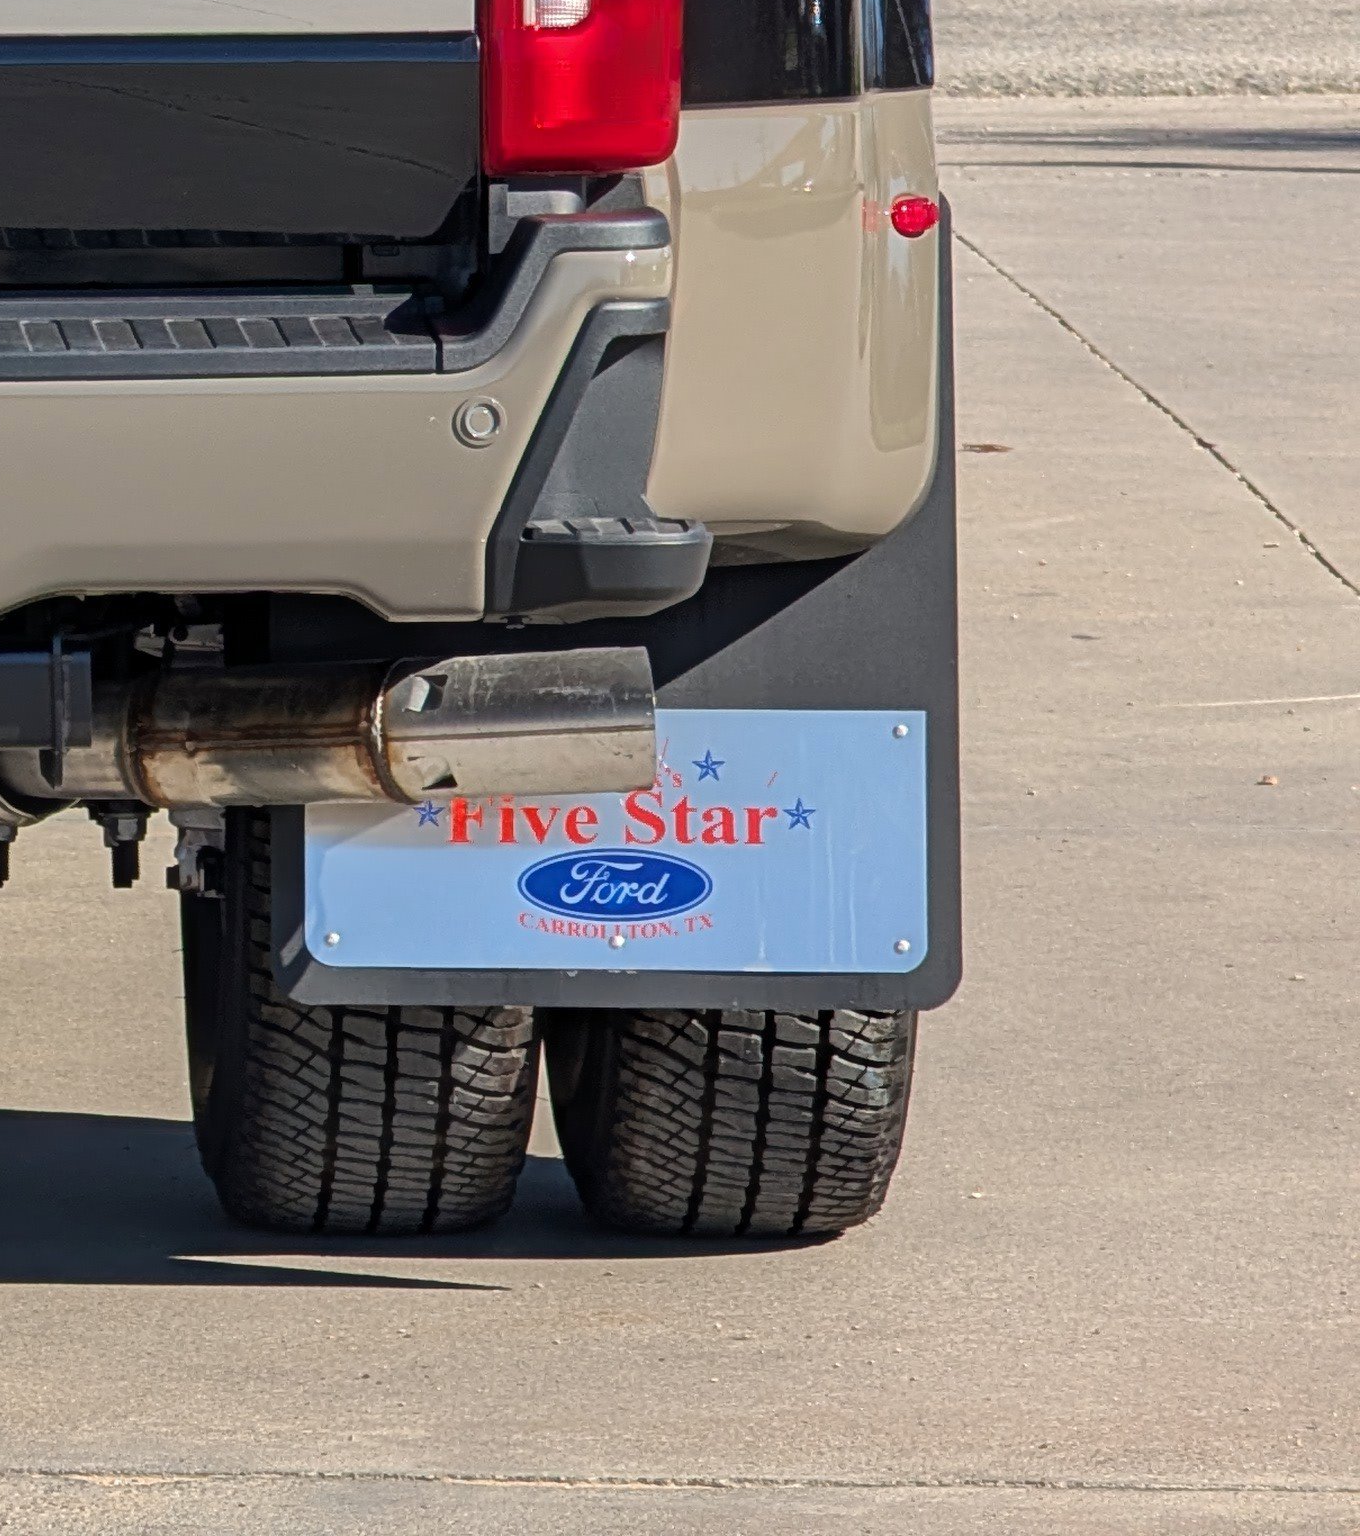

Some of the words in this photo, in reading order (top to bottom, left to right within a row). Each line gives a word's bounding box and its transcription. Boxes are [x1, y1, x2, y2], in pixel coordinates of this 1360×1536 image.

[448, 795, 599, 845] Five
[625, 790, 779, 845] Star
[560, 859, 671, 906] Ford
[684, 913, 714, 932] TX
